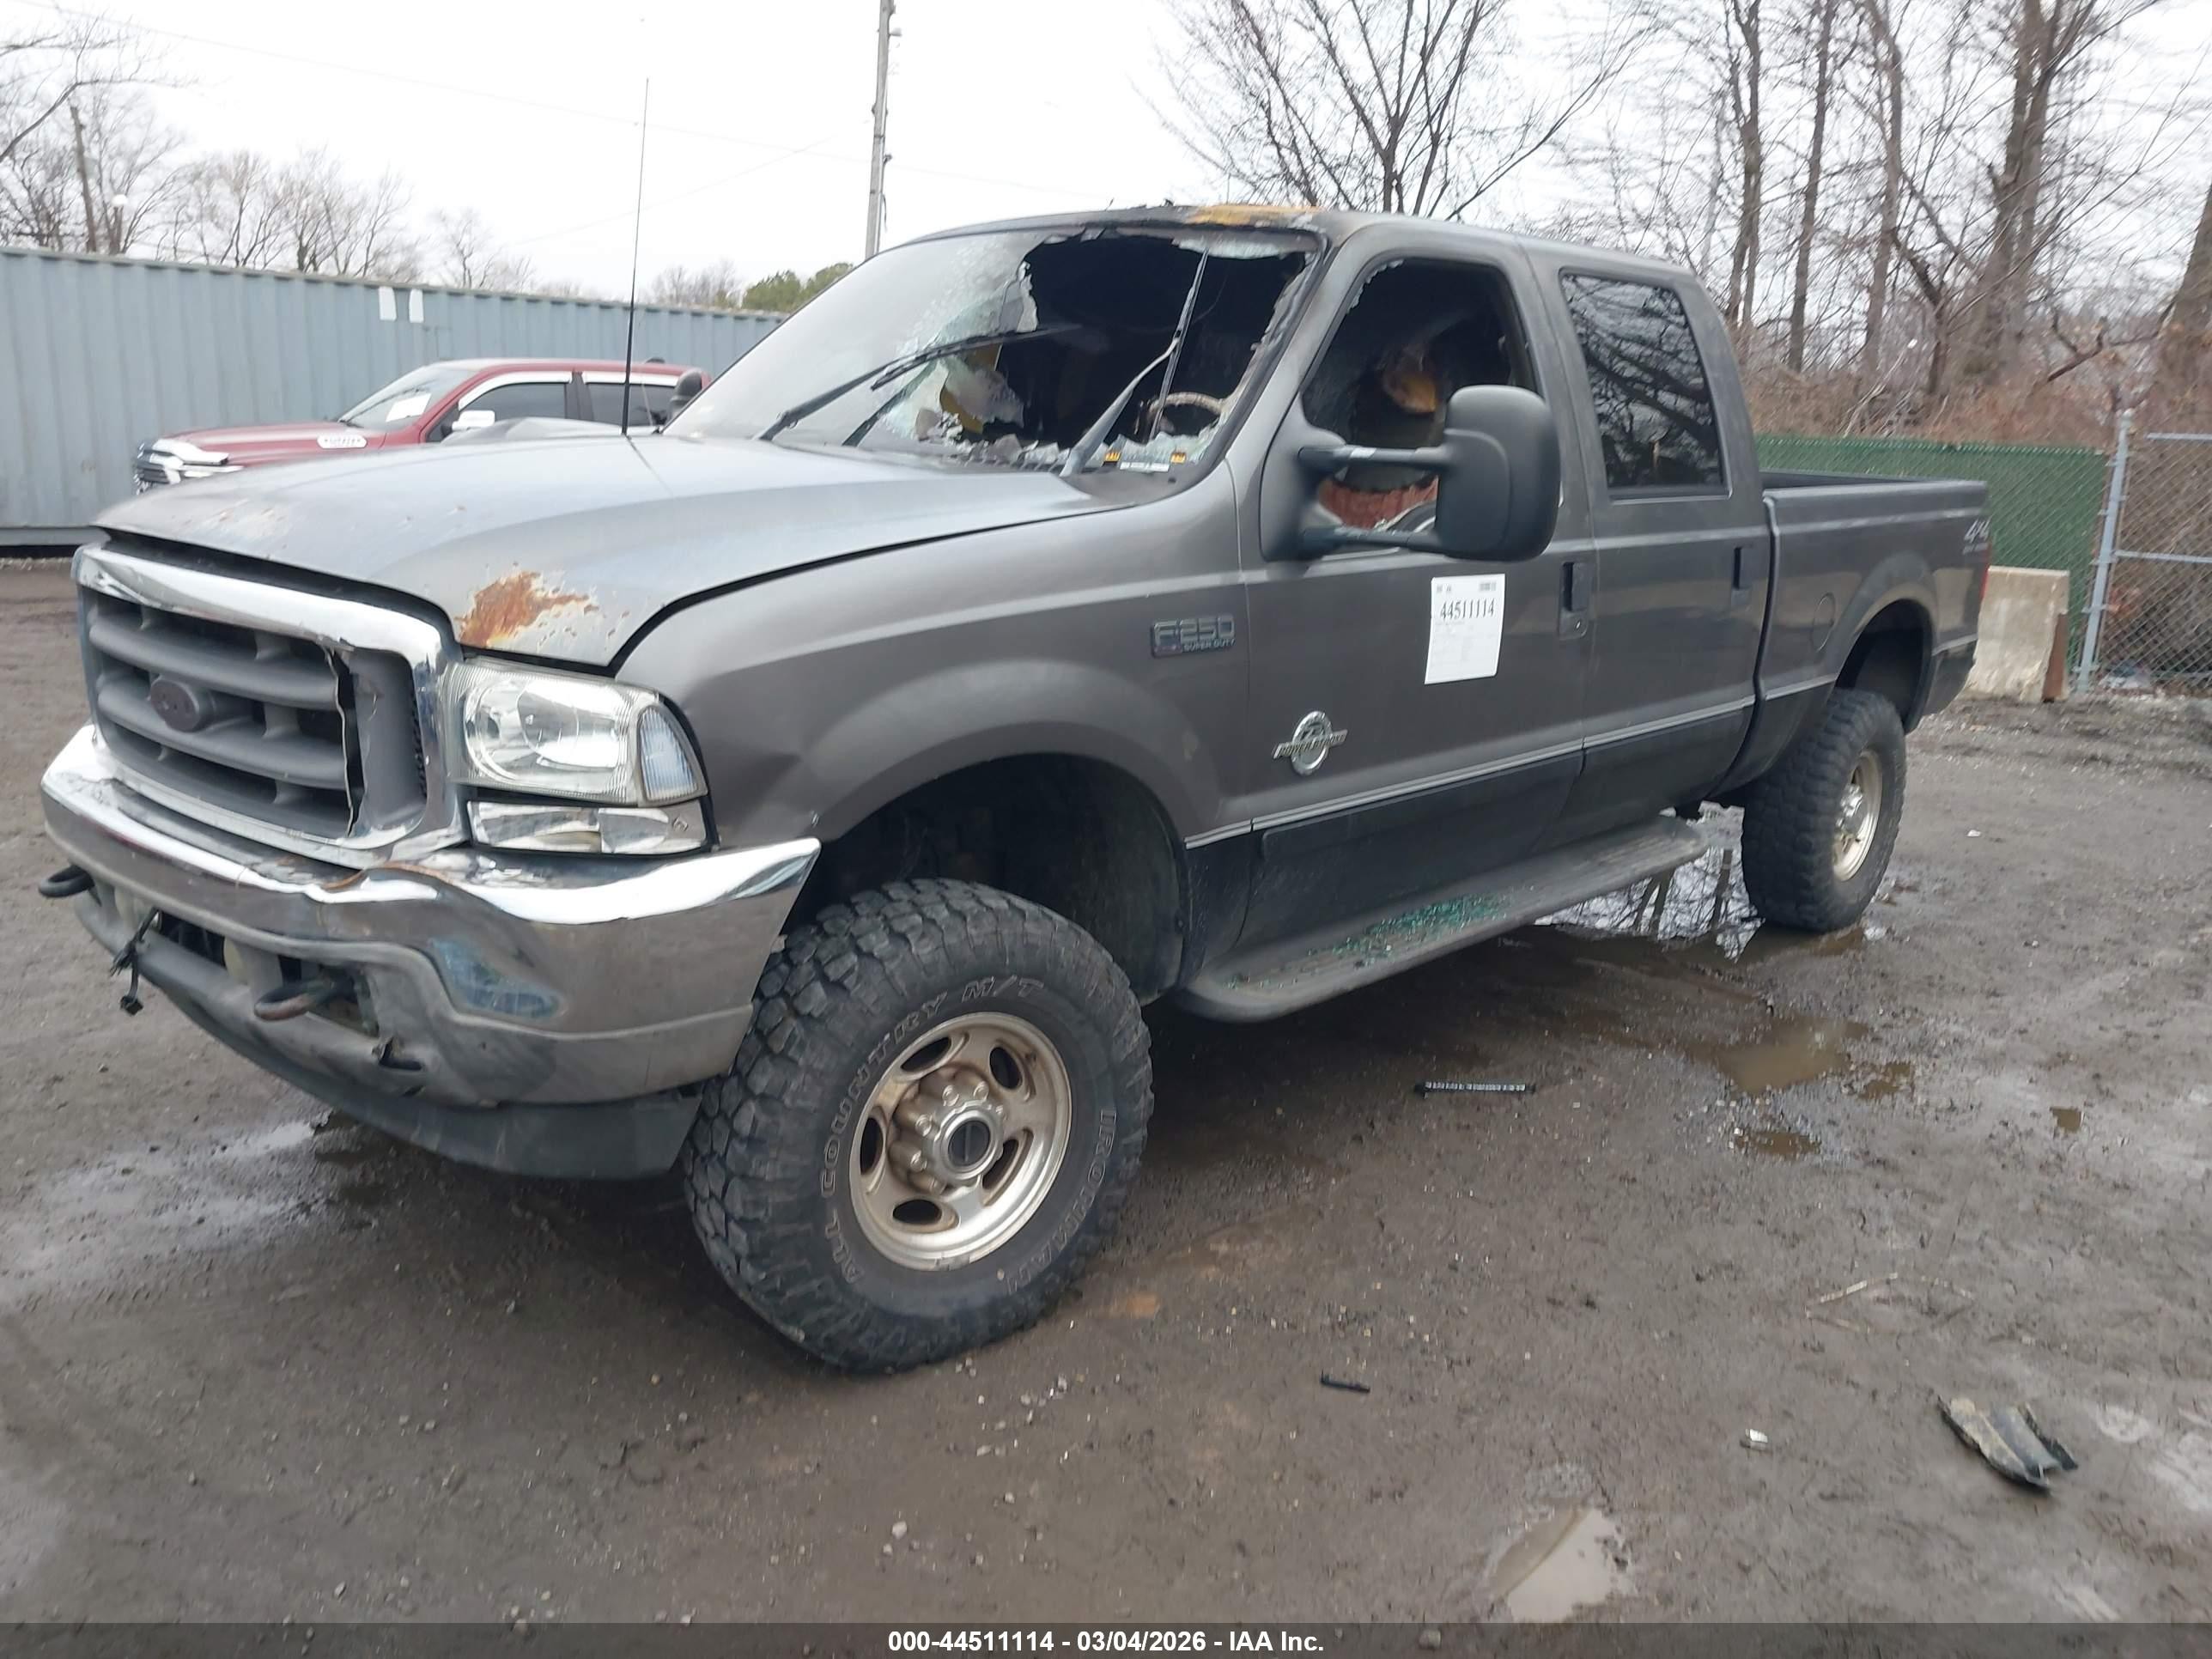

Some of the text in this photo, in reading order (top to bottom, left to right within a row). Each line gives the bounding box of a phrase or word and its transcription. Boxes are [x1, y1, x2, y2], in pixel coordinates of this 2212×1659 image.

[1440, 598, 1495, 620] 44511114
[1212, 638, 1236, 648] DUTY
[821, 975, 1045, 1284] ALL COUNTRY M/T
